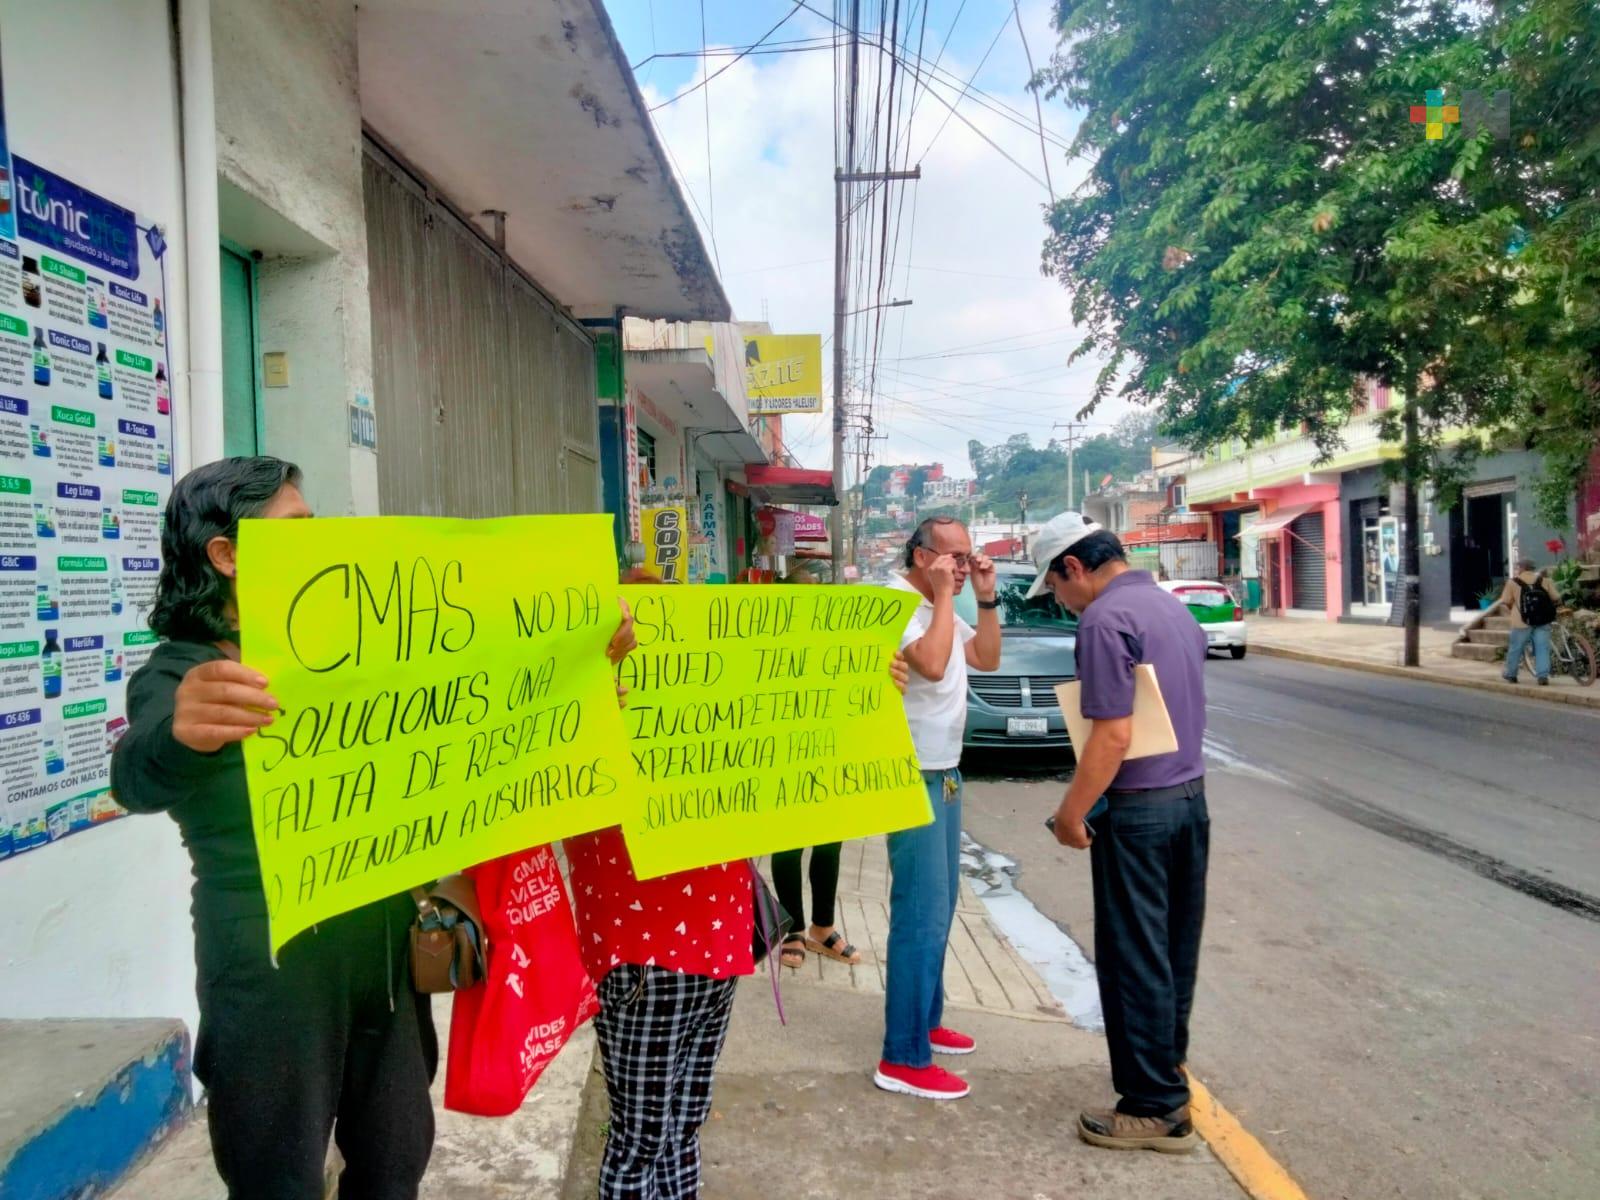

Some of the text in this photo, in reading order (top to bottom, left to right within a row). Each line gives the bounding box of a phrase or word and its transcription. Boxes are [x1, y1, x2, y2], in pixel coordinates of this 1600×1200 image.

[114, 285, 142, 304] Tonic Life
[50, 332, 90, 352] Tonic Clean
[135, 356, 146, 367] Life
[75, 412, 91, 425] Gold
[65, 484, 94, 497] Leg Line
[142, 559, 154, 569] Life
[655, 510, 681, 584] COPI
[287, 556, 600, 673] CMAS NO DA
[633, 593, 902, 647] SR. ALCALDE RICARDO
[617, 643, 886, 692] AHUED TIENE GENTE
[5, 711, 31, 725] OS 436
[65, 701, 106, 715] Hidra Energy
[257, 656, 556, 773] SOLUCIONES UNA
[630, 686, 882, 740] INCOMPETENTE SIN
[787, 728, 836, 764] PARA
[7, 783, 59, 804] CONTAMOS
[60, 777, 78, 789] CON
[98, 767, 109, 778] DE
[262, 699, 581, 844] FALTA DE RESPETO
[775, 776, 787, 811] A
[792, 766, 829, 804] LOS
[833, 754, 922, 796] USUARIOS
[298, 810, 448, 905] ATIENDEN
[459, 798, 477, 838] A
[482, 757, 617, 822] USUARIOS
